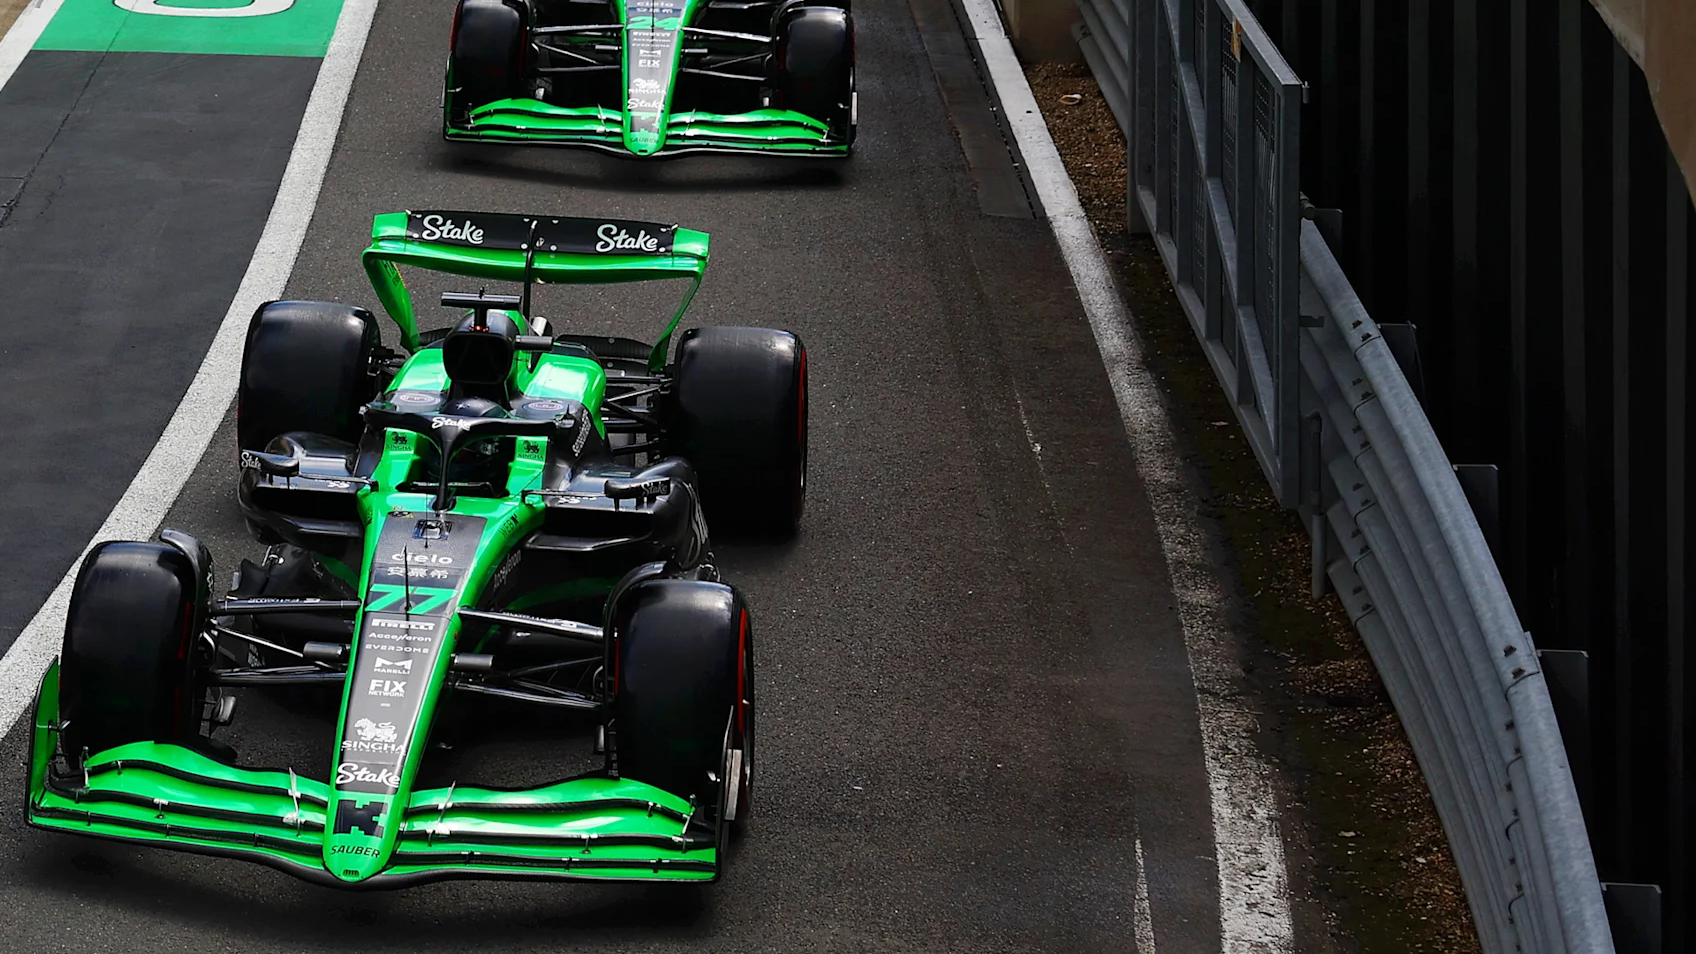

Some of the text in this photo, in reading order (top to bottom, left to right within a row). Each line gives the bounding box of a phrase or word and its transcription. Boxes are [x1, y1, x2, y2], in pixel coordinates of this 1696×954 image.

[626, 16, 682, 30] 24
[638, 59, 661, 67] FIX
[627, 98, 665, 111] Stake
[422, 215, 658, 253] Stake Stake
[431, 417, 472, 432] Stake
[640, 481, 669, 496] Stake
[391, 552, 453, 564] cielo
[365, 584, 458, 615] 77
[371, 618, 435, 631] PIRELLI
[368, 632, 432, 642] Accelleron
[365, 643, 429, 654] EVERDOME
[373, 667, 411, 675] MARELLI
[369, 679, 407, 693] FIX
[368, 690, 405, 698] NETWORK
[341, 740, 406, 752] SINGHA
[336, 762, 401, 788] Stake
[330, 845, 381, 859] SAUBER
